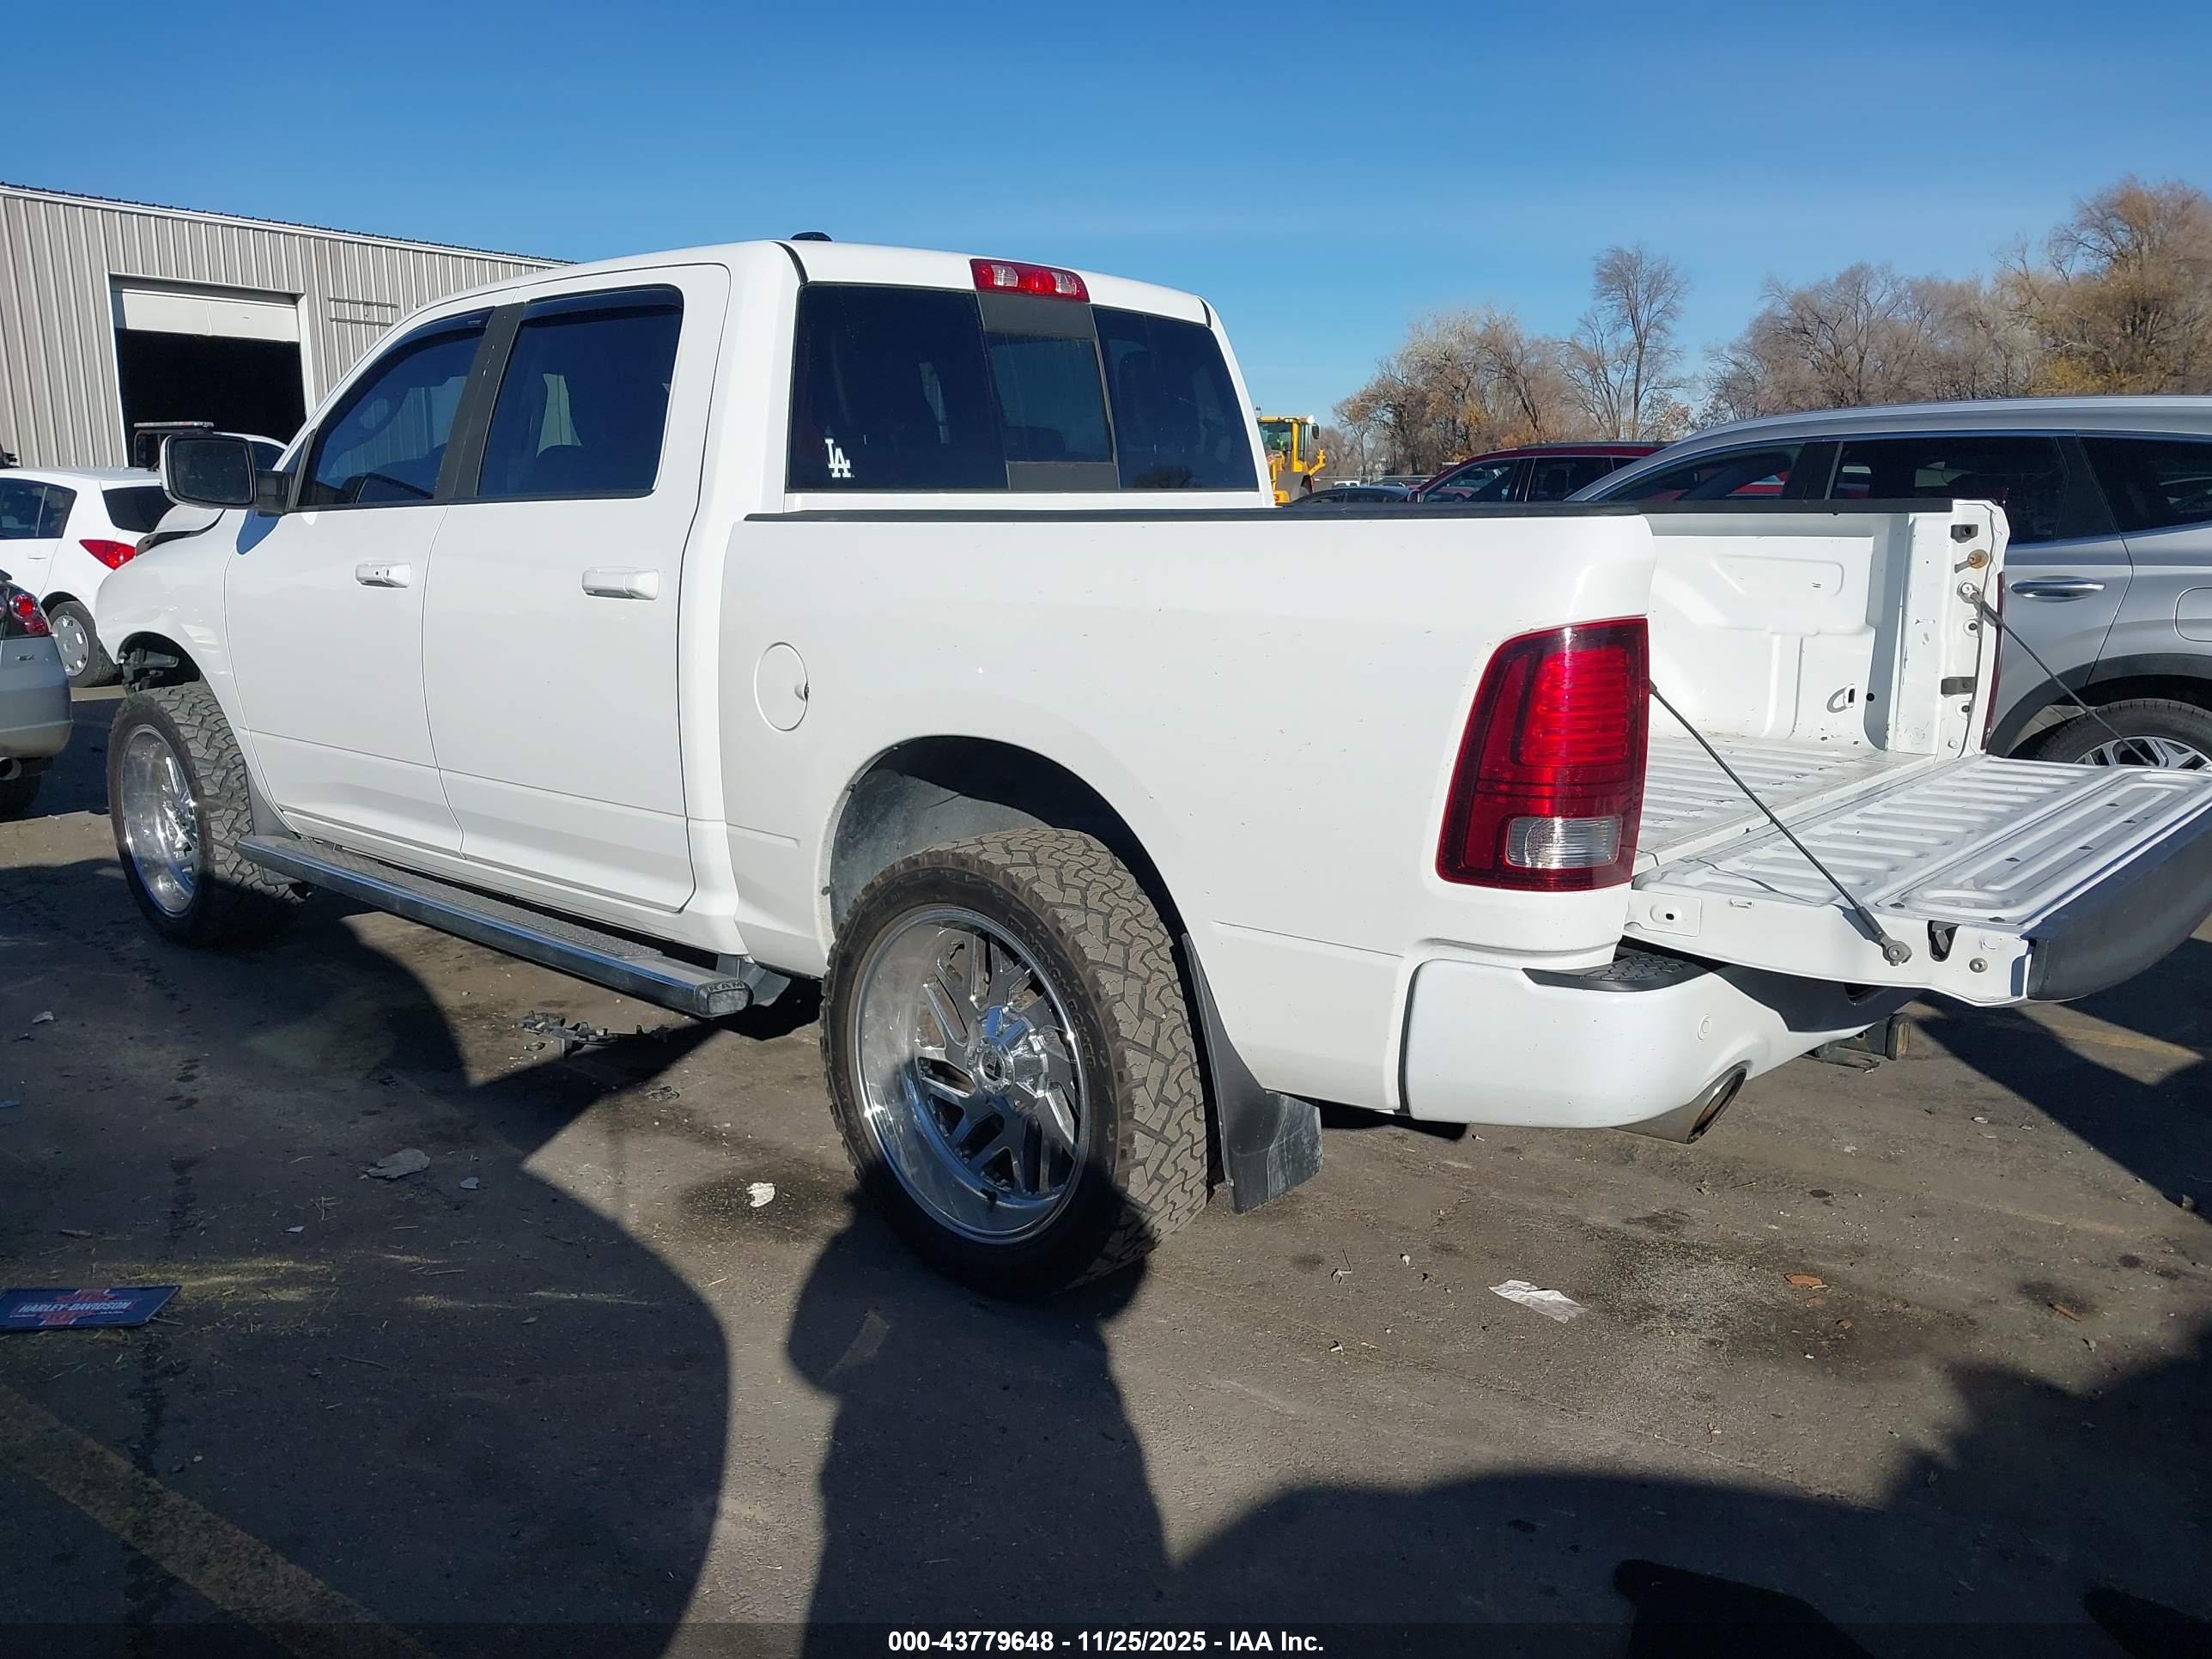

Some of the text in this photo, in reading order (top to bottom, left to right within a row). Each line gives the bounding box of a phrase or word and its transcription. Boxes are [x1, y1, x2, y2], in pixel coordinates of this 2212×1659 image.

[825, 438, 852, 478] LA
[708, 981, 745, 993] RAM
[18, 1301, 132, 1313] HARLEY-DAVIDSON
